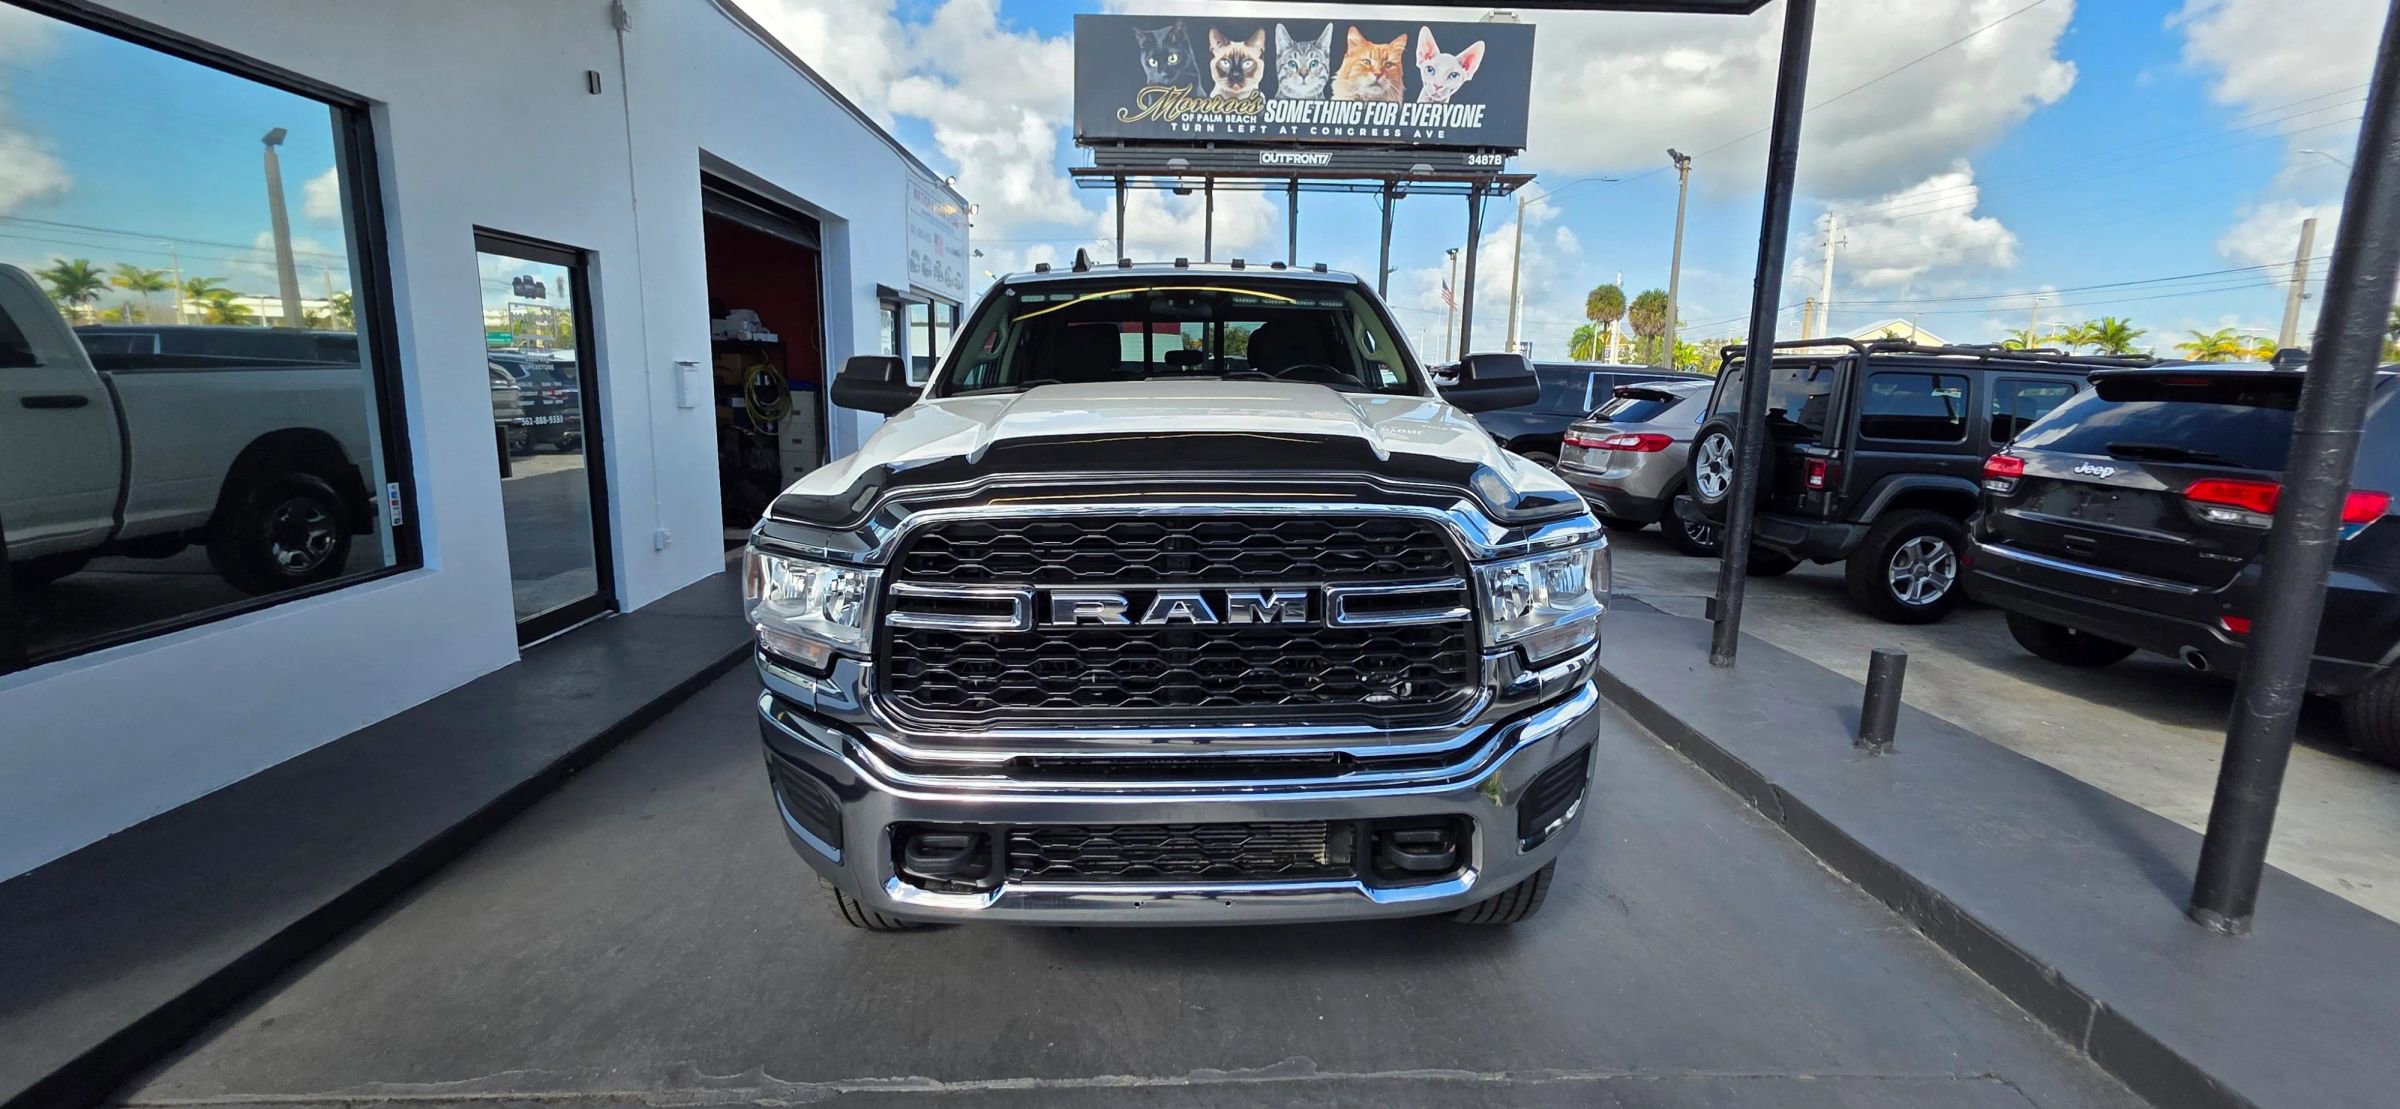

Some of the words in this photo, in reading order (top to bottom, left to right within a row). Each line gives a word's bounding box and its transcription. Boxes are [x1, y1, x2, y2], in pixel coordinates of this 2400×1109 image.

[1181, 113, 1195, 122] OF
[1196, 113, 1223, 123] PALM
[1225, 114, 1257, 124] BEACH
[1264, 99, 1363, 125] SOMETHING
[1364, 101, 1399, 126] FOR
[1399, 103, 1486, 128] EVERYONE
[1170, 122, 1215, 132] TURN
[1227, 124, 1268, 133] LEFT
[1279, 126, 1298, 135] AT
[1310, 126, 1402, 138] CONGRESS
[1413, 129, 1446, 139] AVE
[1468, 154, 1503, 166] 3487B
[2073, 461, 2116, 479] Jeep
[1050, 590, 1308, 625] RAM
